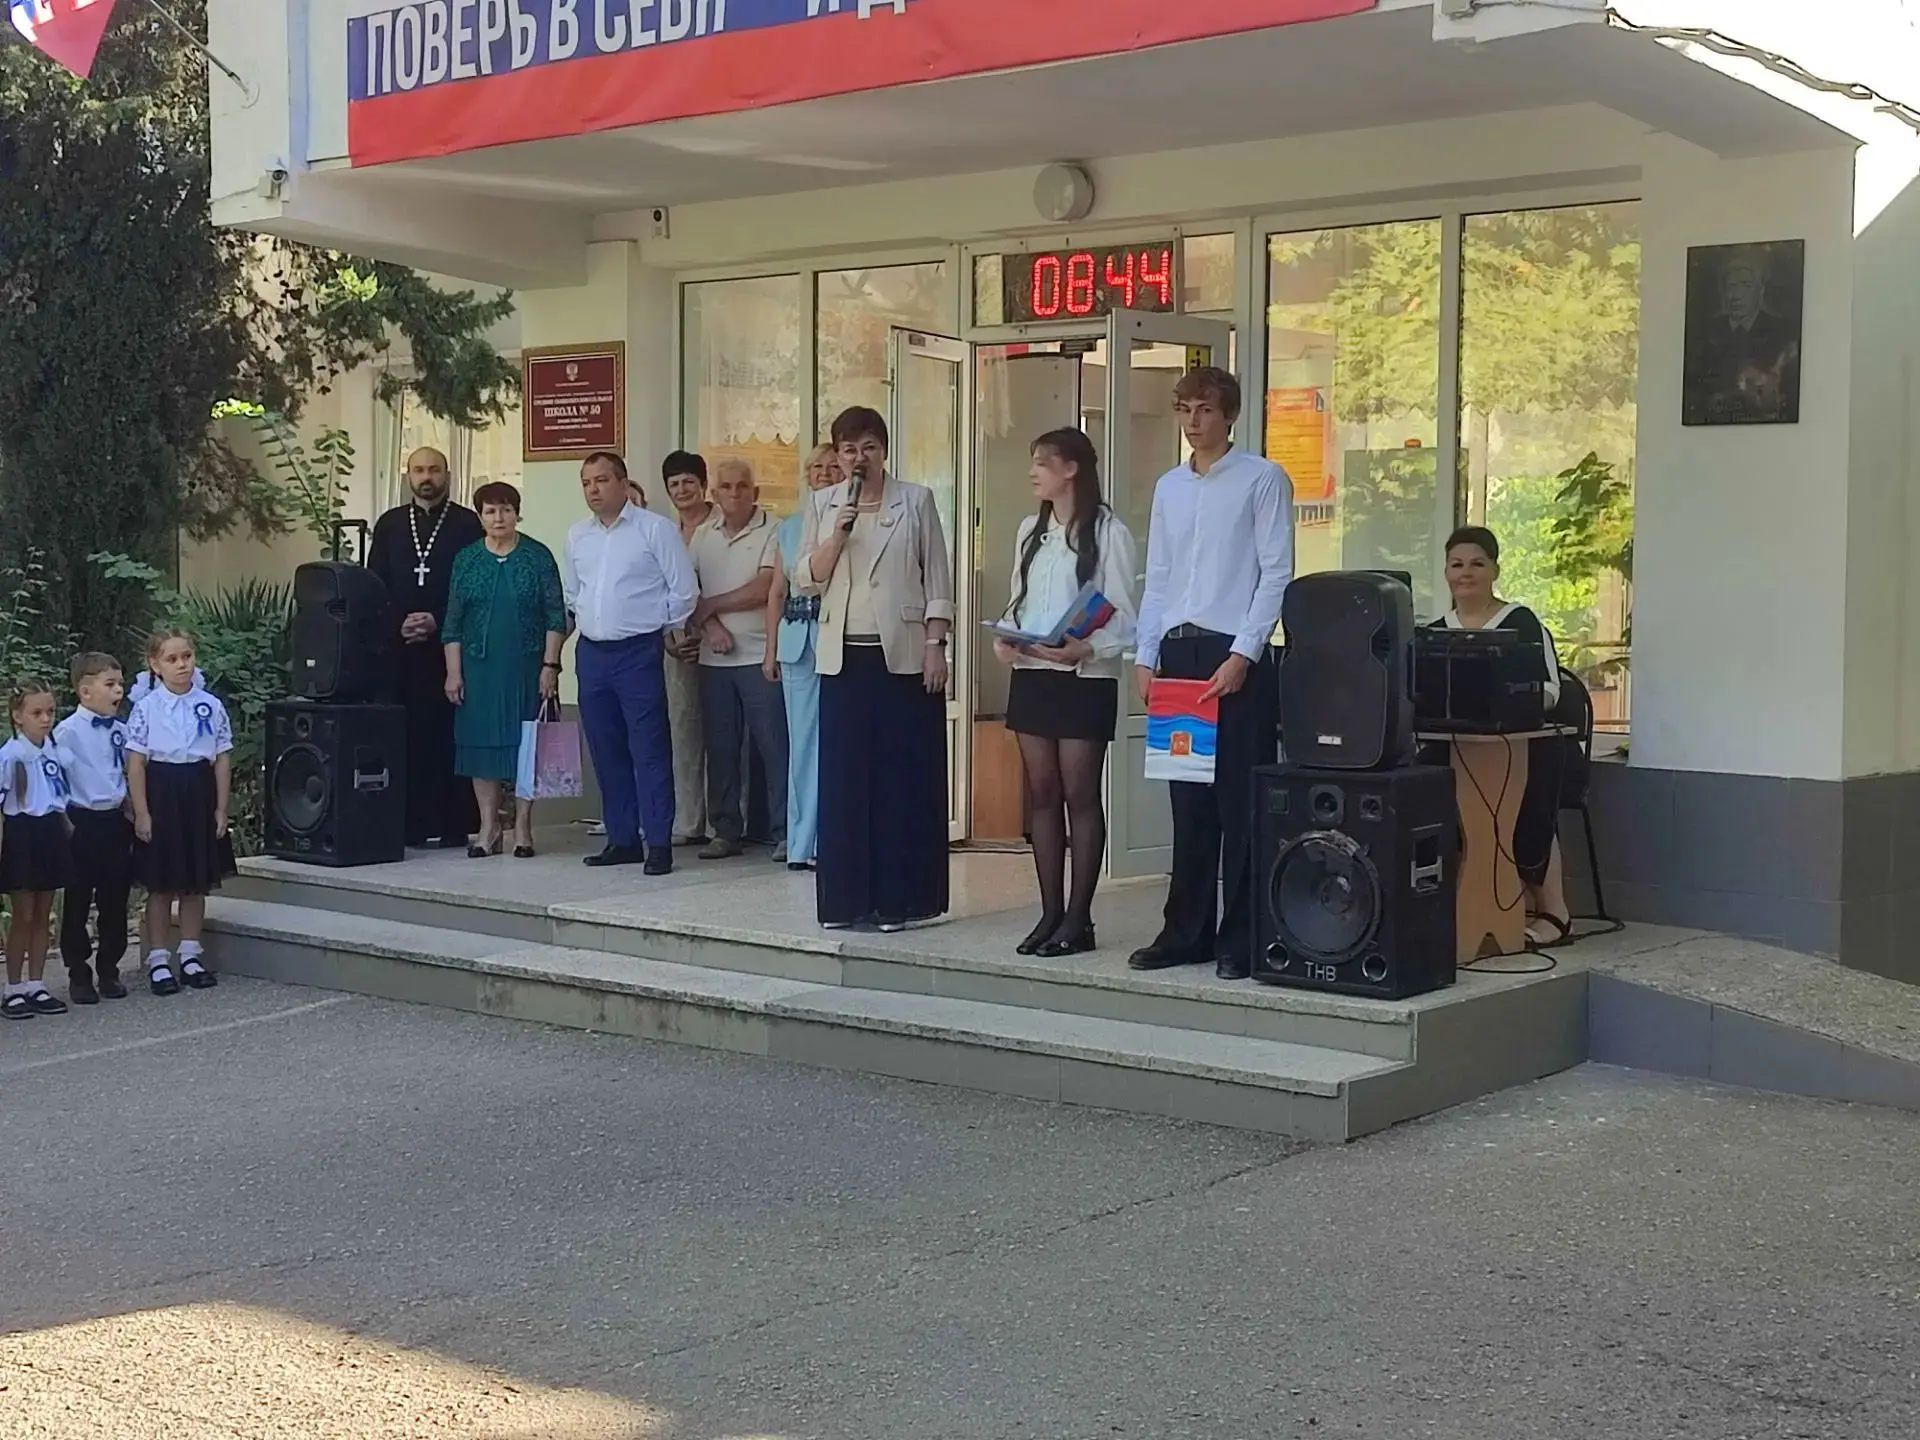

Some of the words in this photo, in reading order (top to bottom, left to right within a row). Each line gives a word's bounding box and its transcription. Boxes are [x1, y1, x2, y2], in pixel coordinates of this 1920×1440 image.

[366, 0, 537, 97] ПОВЕРЬ
[548, 0, 579, 61] В
[544, 405, 578, 418] ШКОЛА
[1304, 961, 1337, 982] THB
